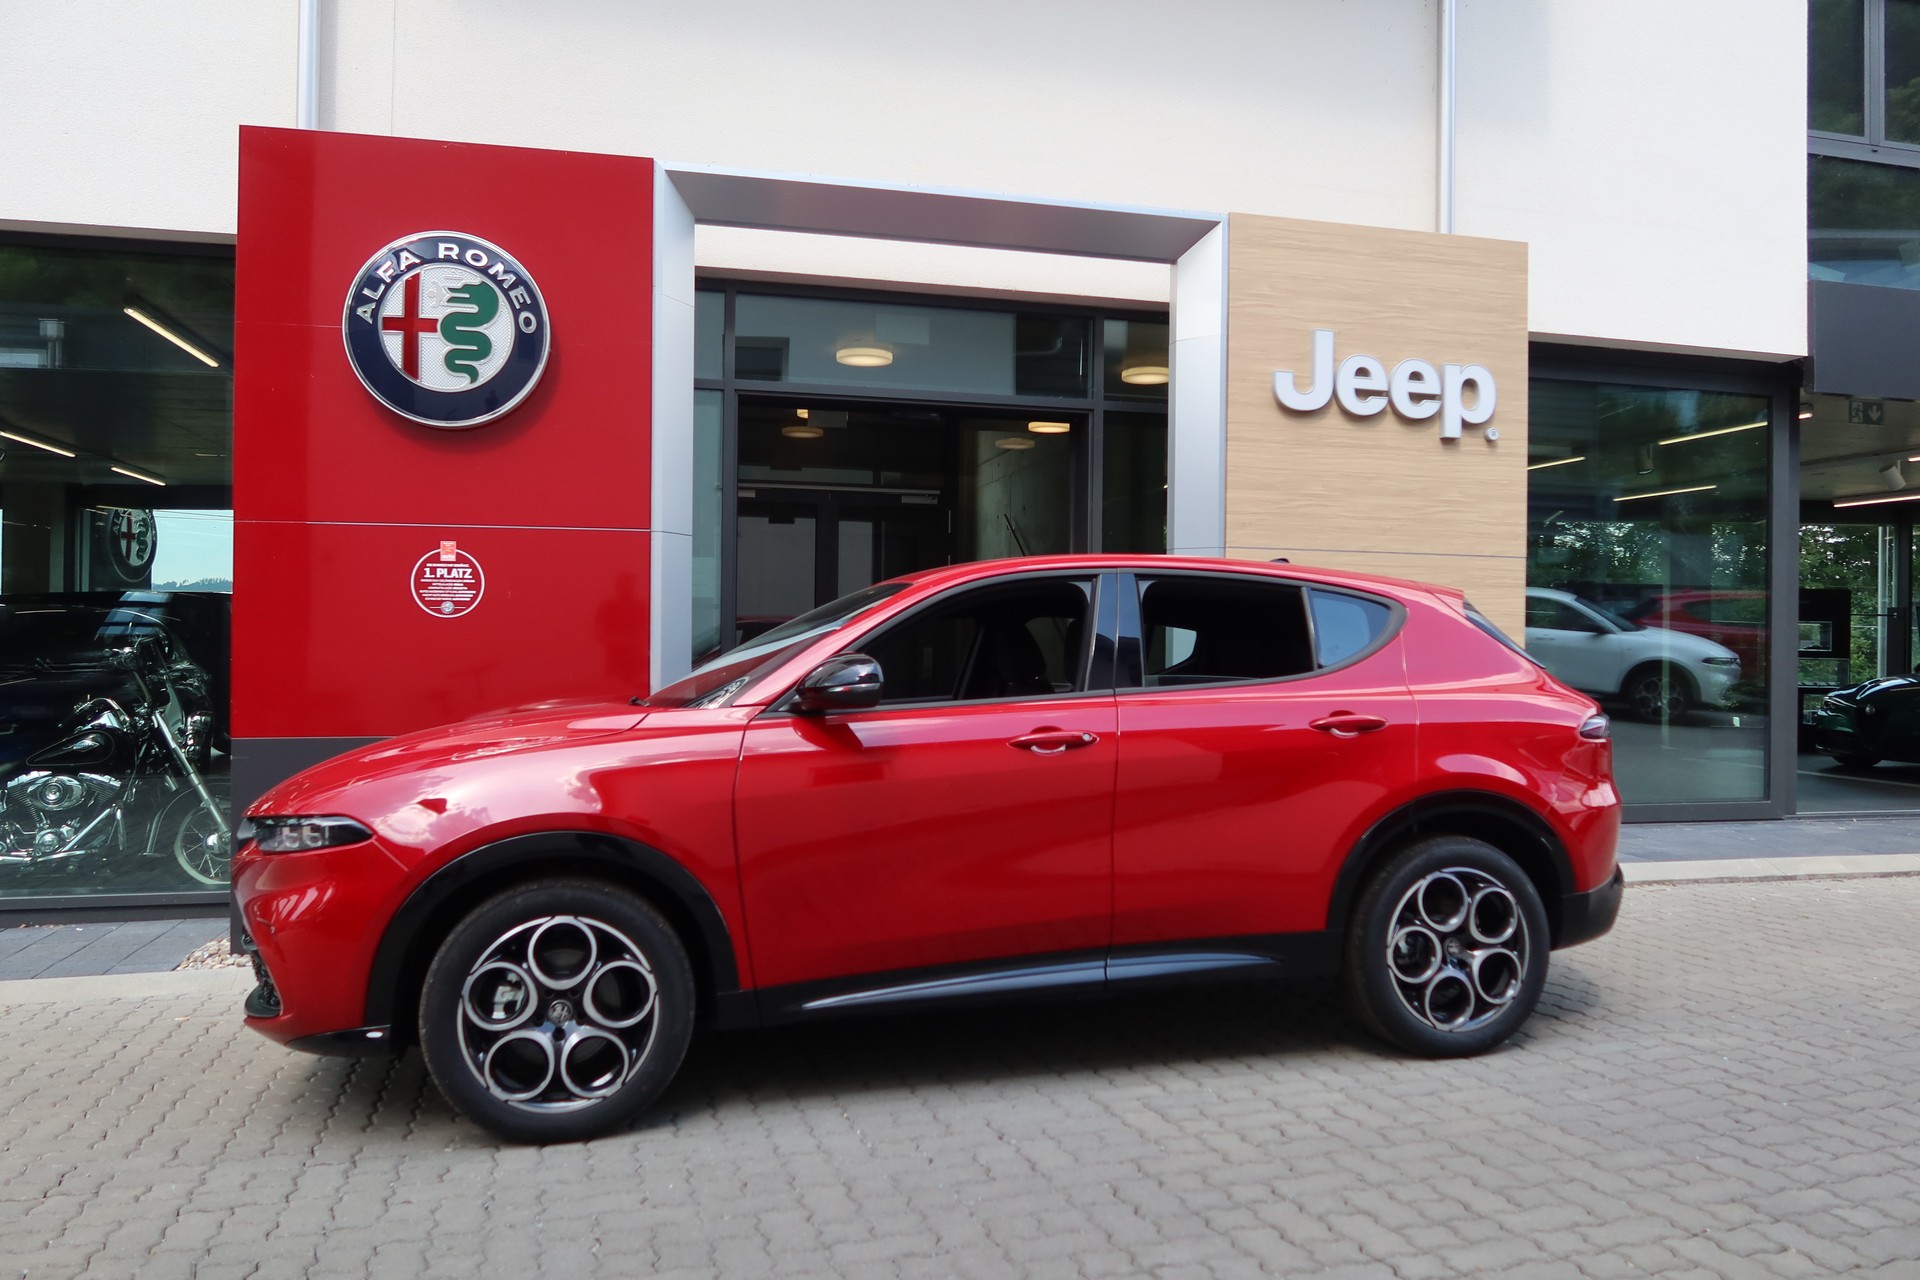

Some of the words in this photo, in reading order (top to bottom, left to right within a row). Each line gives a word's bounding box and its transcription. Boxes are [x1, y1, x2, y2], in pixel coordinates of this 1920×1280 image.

[356, 249, 421, 325] ALFA
[437, 242, 537, 334] ROMEO
[1272, 328, 1497, 439] Jeep
[436, 567, 473, 579] PLATZ
